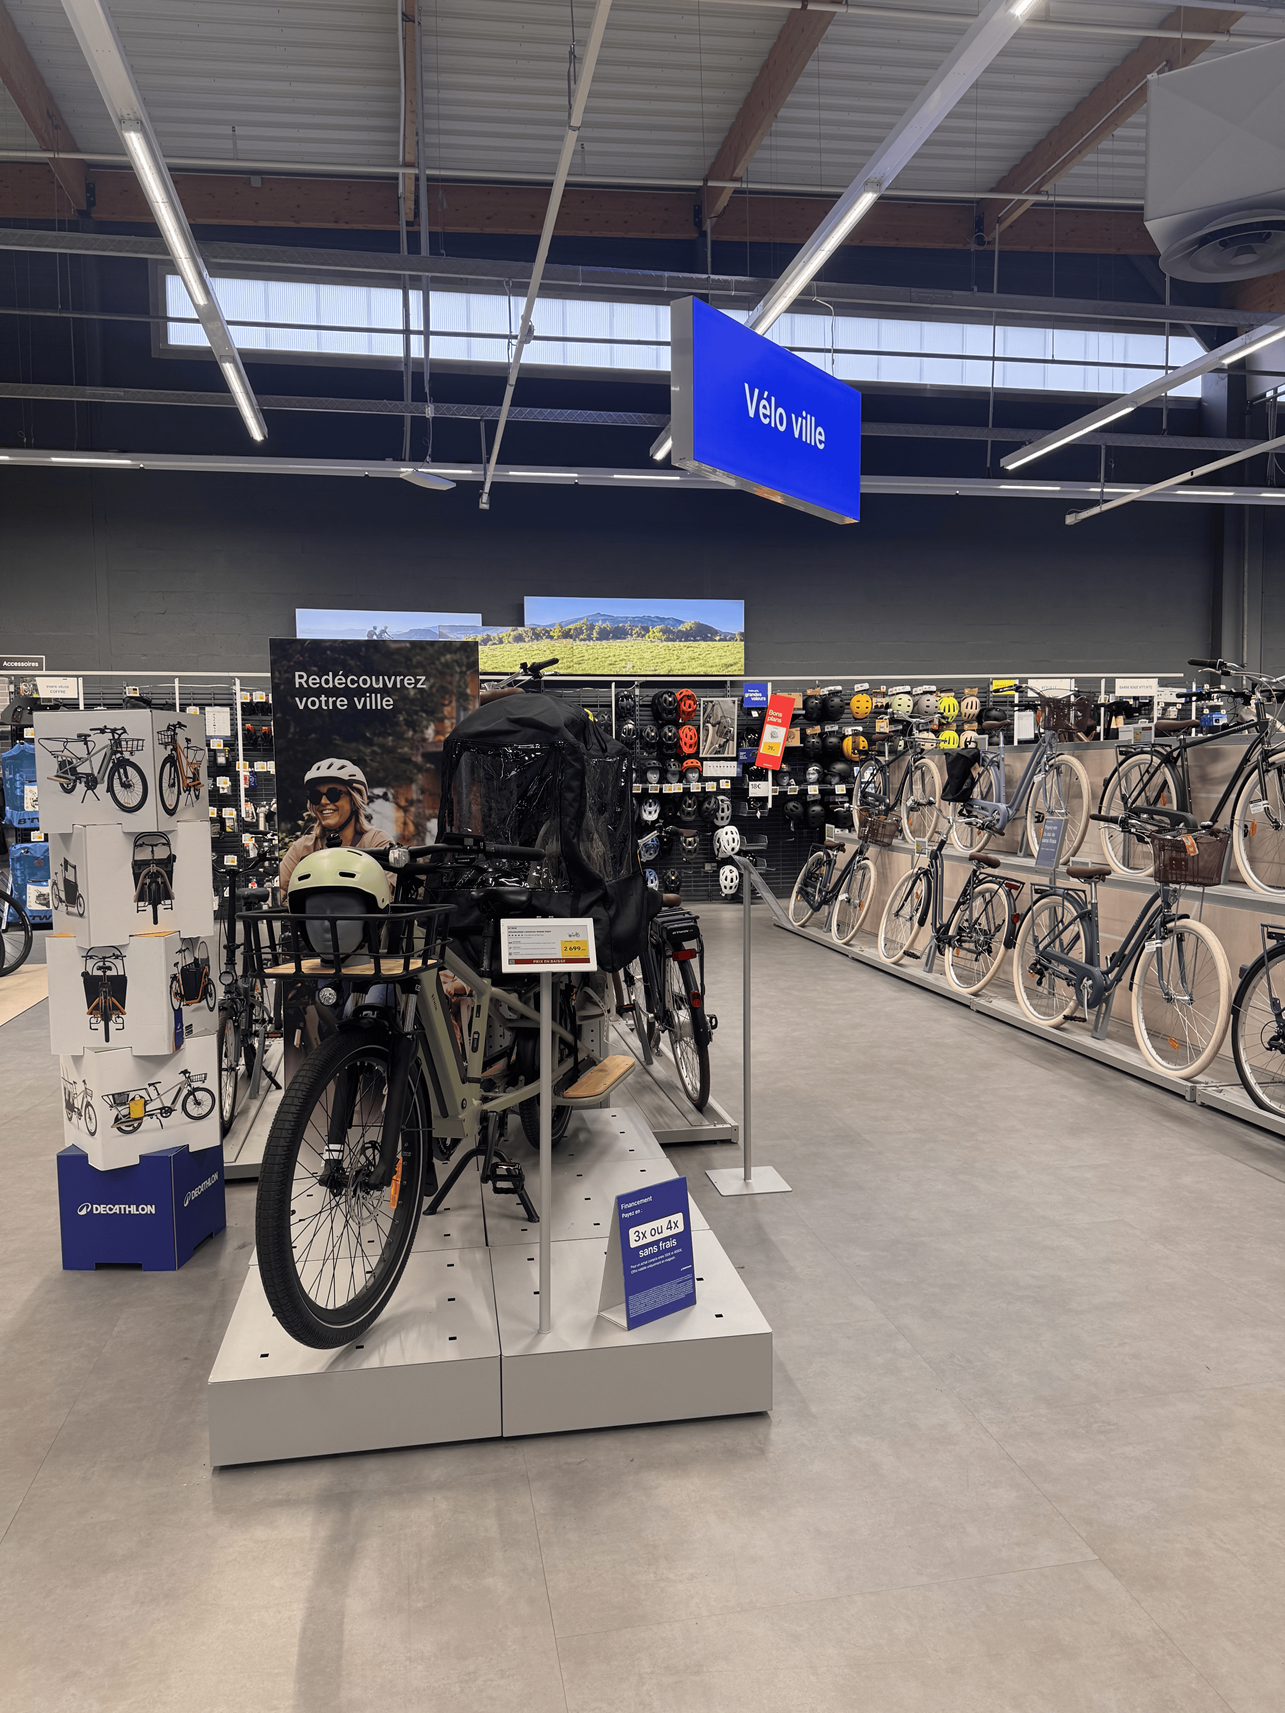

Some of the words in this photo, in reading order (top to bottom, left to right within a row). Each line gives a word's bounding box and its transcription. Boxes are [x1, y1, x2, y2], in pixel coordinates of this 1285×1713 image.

[744, 382, 787, 432] Vélo
[791, 410, 826, 450] ville
[294, 670, 426, 688] Redécouvrez
[295, 694, 348, 710] votre
[354, 693, 394, 710] ville
[190, 1171, 219, 1200] DECATHLON
[92, 1204, 156, 1214] DECATHLON
[621, 1196, 653, 1210] Financement
[622, 1211, 634, 1219] Payez
[633, 1230, 647, 1243] 3x
[650, 1225, 663, 1237] ou
[666, 1219, 680, 1231] 4x
[638, 1244, 658, 1258] sans
[660, 1238, 677, 1251] frais
